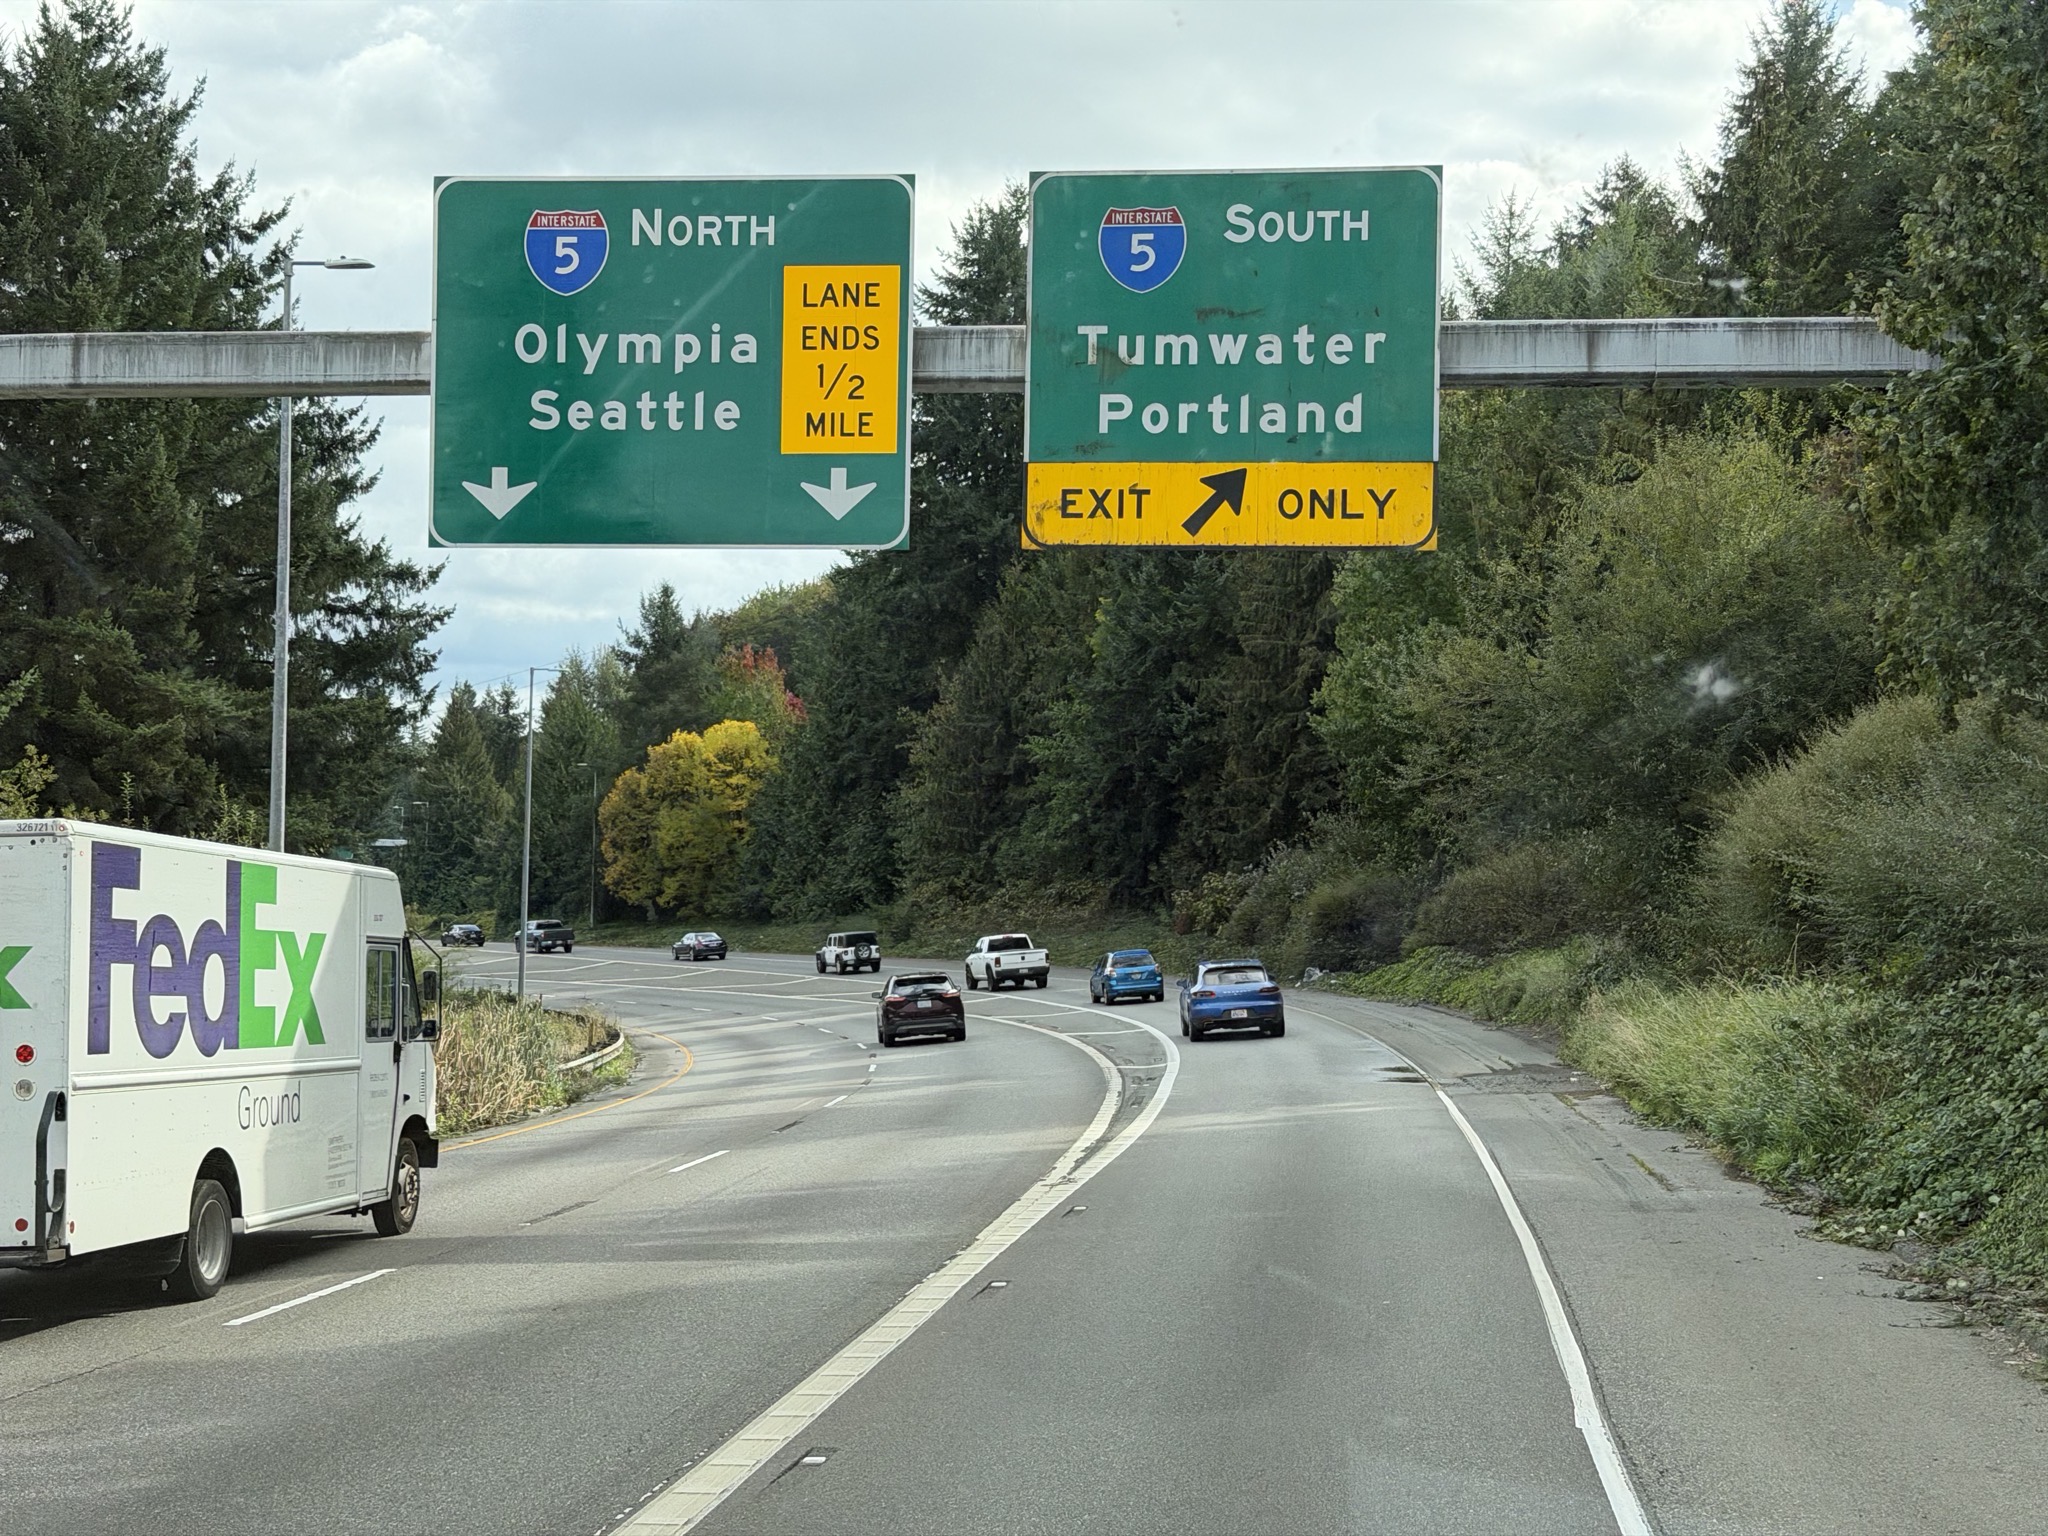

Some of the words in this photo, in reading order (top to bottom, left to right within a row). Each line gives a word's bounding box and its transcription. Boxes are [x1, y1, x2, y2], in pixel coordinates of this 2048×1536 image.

[537, 215, 597, 227] INTERSTATE
[631, 208, 775, 246] NORTH
[1111, 211, 1174, 224] INTERSTATE
[1223, 203, 1370, 243] SOUTH
[554, 236, 580, 275] 5
[1130, 233, 1156, 272] 5
[801, 282, 881, 308] LANE
[514, 323, 758, 375] Olympia
[801, 325, 880, 351] ENDS
[1077, 324, 1387, 366] Tumwater
[816, 363, 865, 400] 1/2
[528, 389, 741, 431] Seattle
[805, 412, 874, 437] MILE
[1098, 393, 1363, 434] Portland
[1060, 488, 1151, 520] EXIT
[1277, 488, 1398, 520] ONLY
[87, 840, 327, 1060] FedEx
[238, 1080, 301, 1130] Ground
